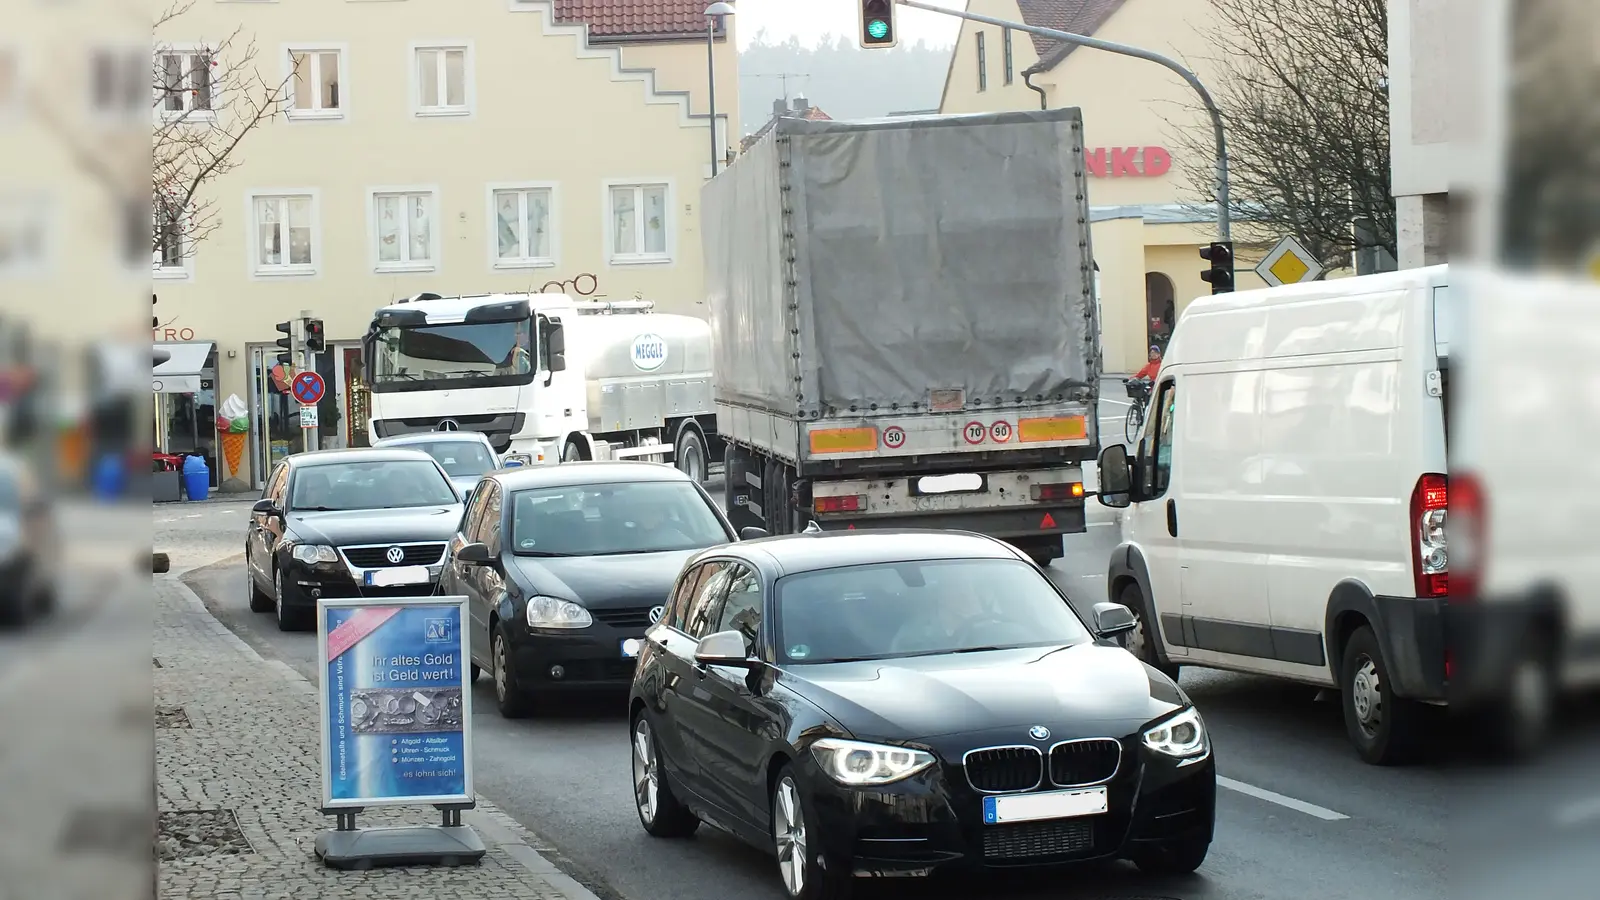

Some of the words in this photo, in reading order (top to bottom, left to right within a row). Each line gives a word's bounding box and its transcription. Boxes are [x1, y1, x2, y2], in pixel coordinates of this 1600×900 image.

[1084, 146, 1172, 178] NKD
[635, 342, 663, 359] MEGGLE
[969, 427, 981, 438] 70
[995, 426, 1007, 437] 90
[888, 433, 900, 442] 50
[372, 655, 387, 667] Ihr
[391, 654, 420, 667] altes
[424, 653, 453, 666] Gold
[372, 670, 384, 682] ist
[389, 669, 418, 681] Geld
[422, 668, 453, 680] wert!
[401, 738, 421, 746] Altgold
[339, 741, 347, 781] Edelmetalle
[403, 770, 413, 778] es
[416, 769, 435, 778] lohnt
[437, 768, 456, 777] sich!
[988, 812, 993, 820] D
